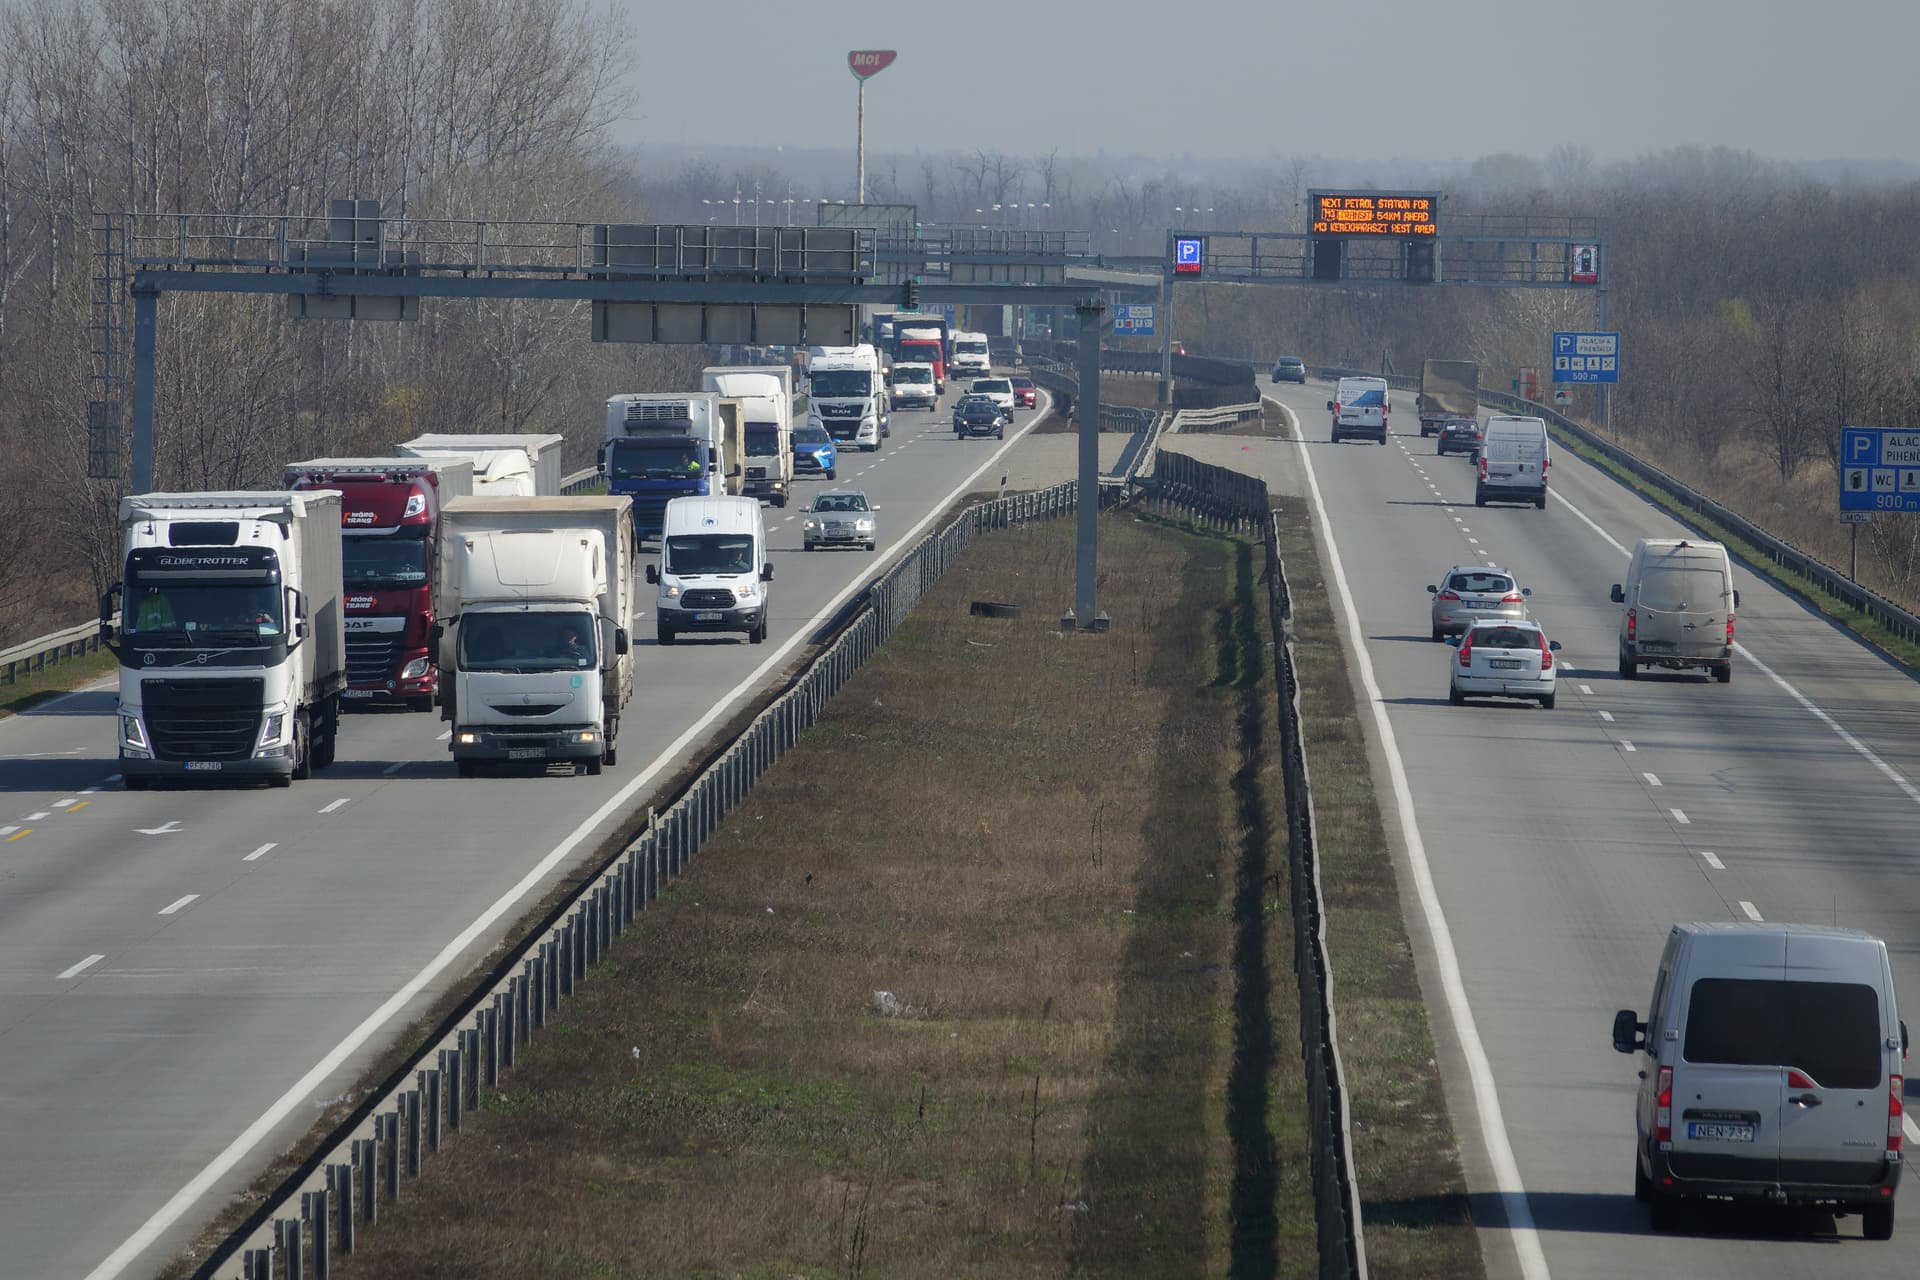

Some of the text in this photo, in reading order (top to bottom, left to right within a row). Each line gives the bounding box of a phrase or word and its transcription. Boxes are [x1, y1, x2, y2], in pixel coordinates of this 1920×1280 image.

[1321, 198, 1429, 210] NEXT PETROL STATION FOR
[1403, 212, 1429, 222] AHEAD
[1313, 222, 1328, 233] M3
[1391, 223, 1412, 233] REST
[1414, 224, 1435, 234] AREA
[1183, 244, 1195, 260] P
[1560, 337, 1571, 352] P
[1854, 436, 1872, 460] P
[1875, 474, 1893, 487] WC
[1876, 495, 1918, 509] 900 m
[1846, 513, 1867, 522] MOL
[160, 557, 249, 566] GLOBETROTTER
